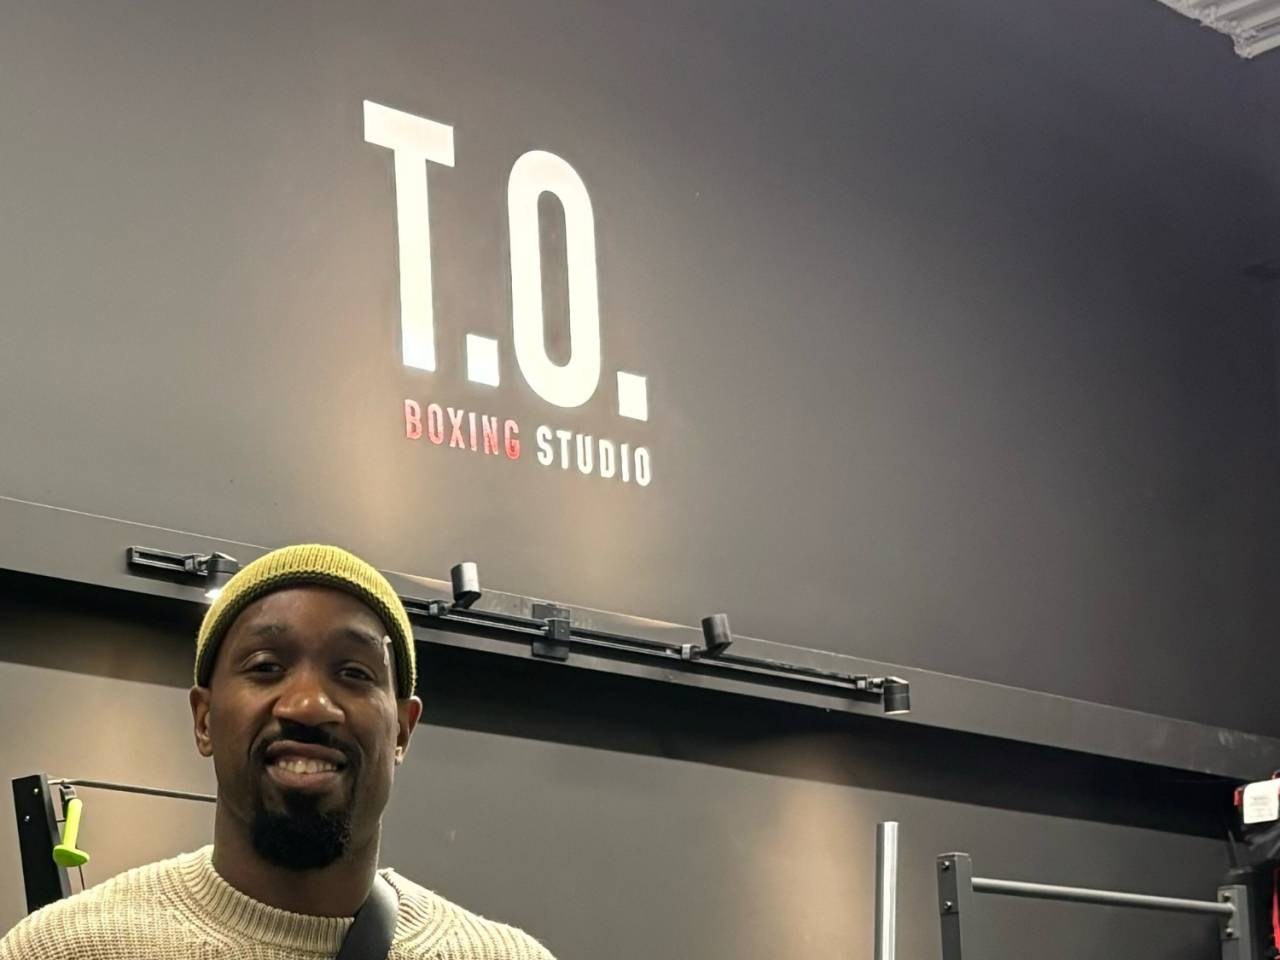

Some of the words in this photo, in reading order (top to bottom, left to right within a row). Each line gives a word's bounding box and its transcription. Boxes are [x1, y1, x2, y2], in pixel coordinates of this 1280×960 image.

[363, 99, 649, 422] T.O.
[404, 398, 521, 460] BOXING
[535, 424, 651, 487] STUDIO
